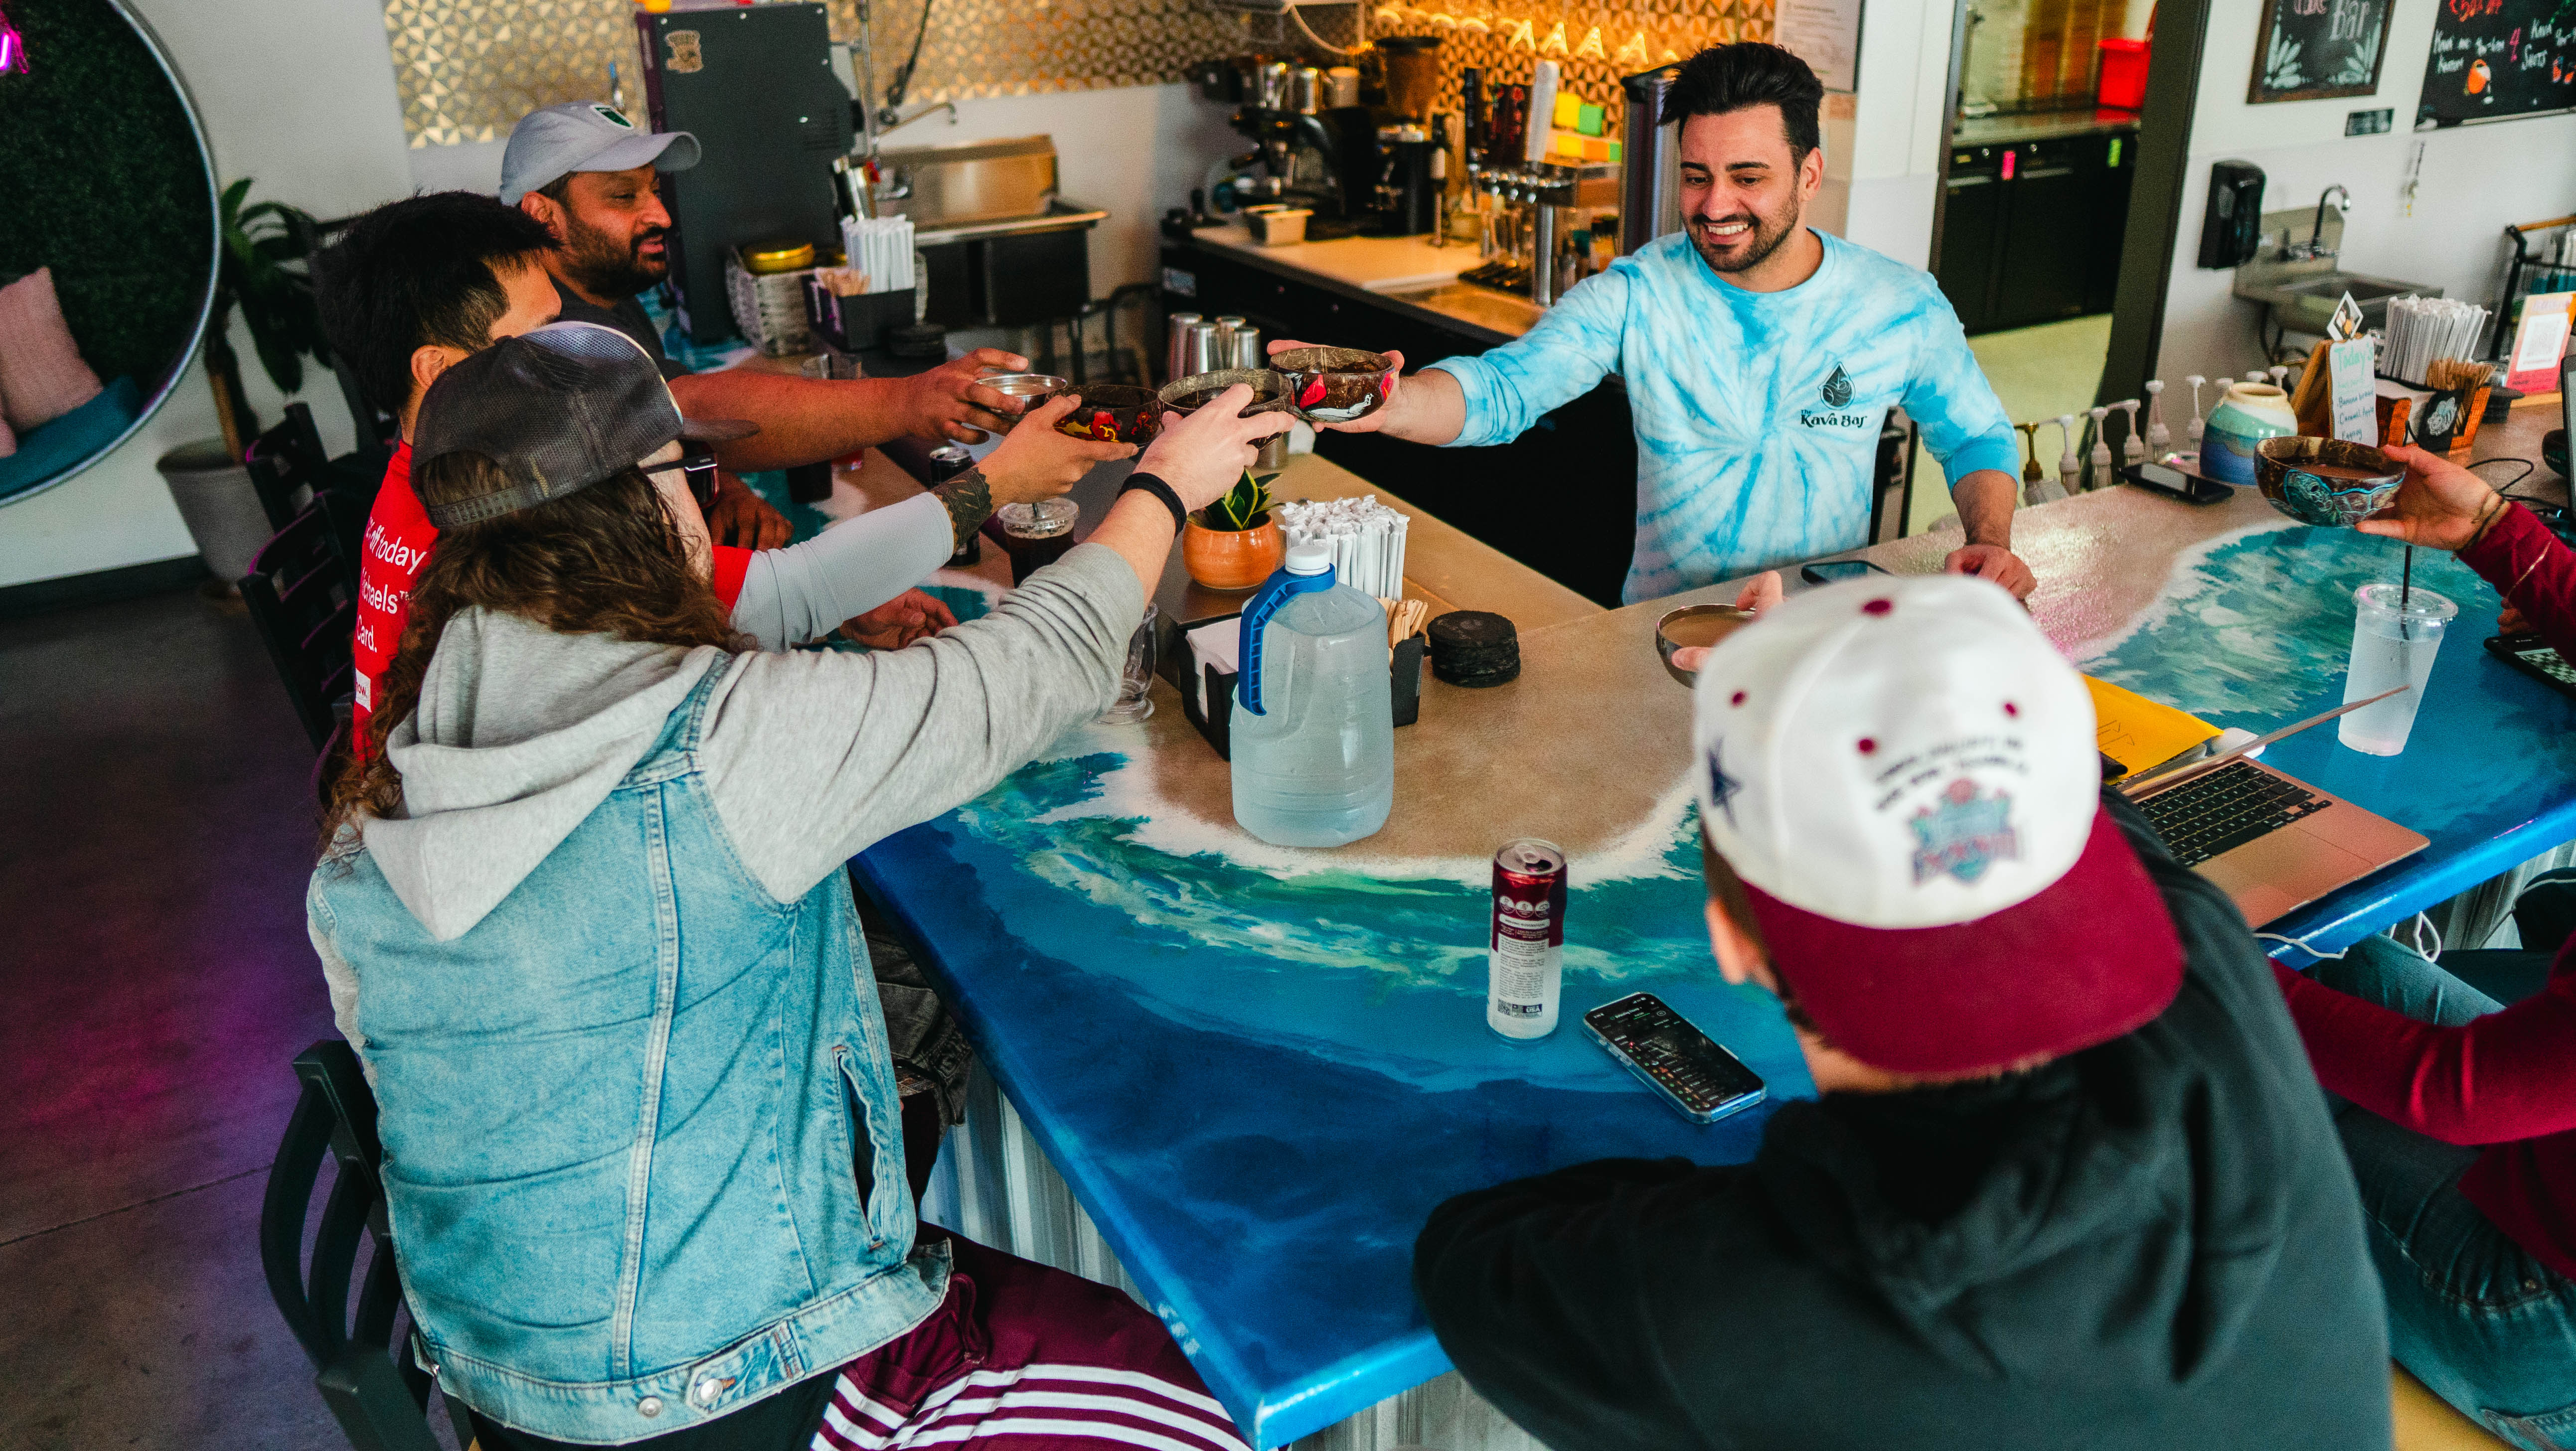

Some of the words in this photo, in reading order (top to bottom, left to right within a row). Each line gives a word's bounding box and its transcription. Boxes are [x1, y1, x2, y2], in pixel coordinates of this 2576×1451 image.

[1800, 413, 1838, 428] Kava
[1841, 415, 1868, 428] Bar
[375, 534, 427, 575] today
[357, 614, 377, 653] Card.
